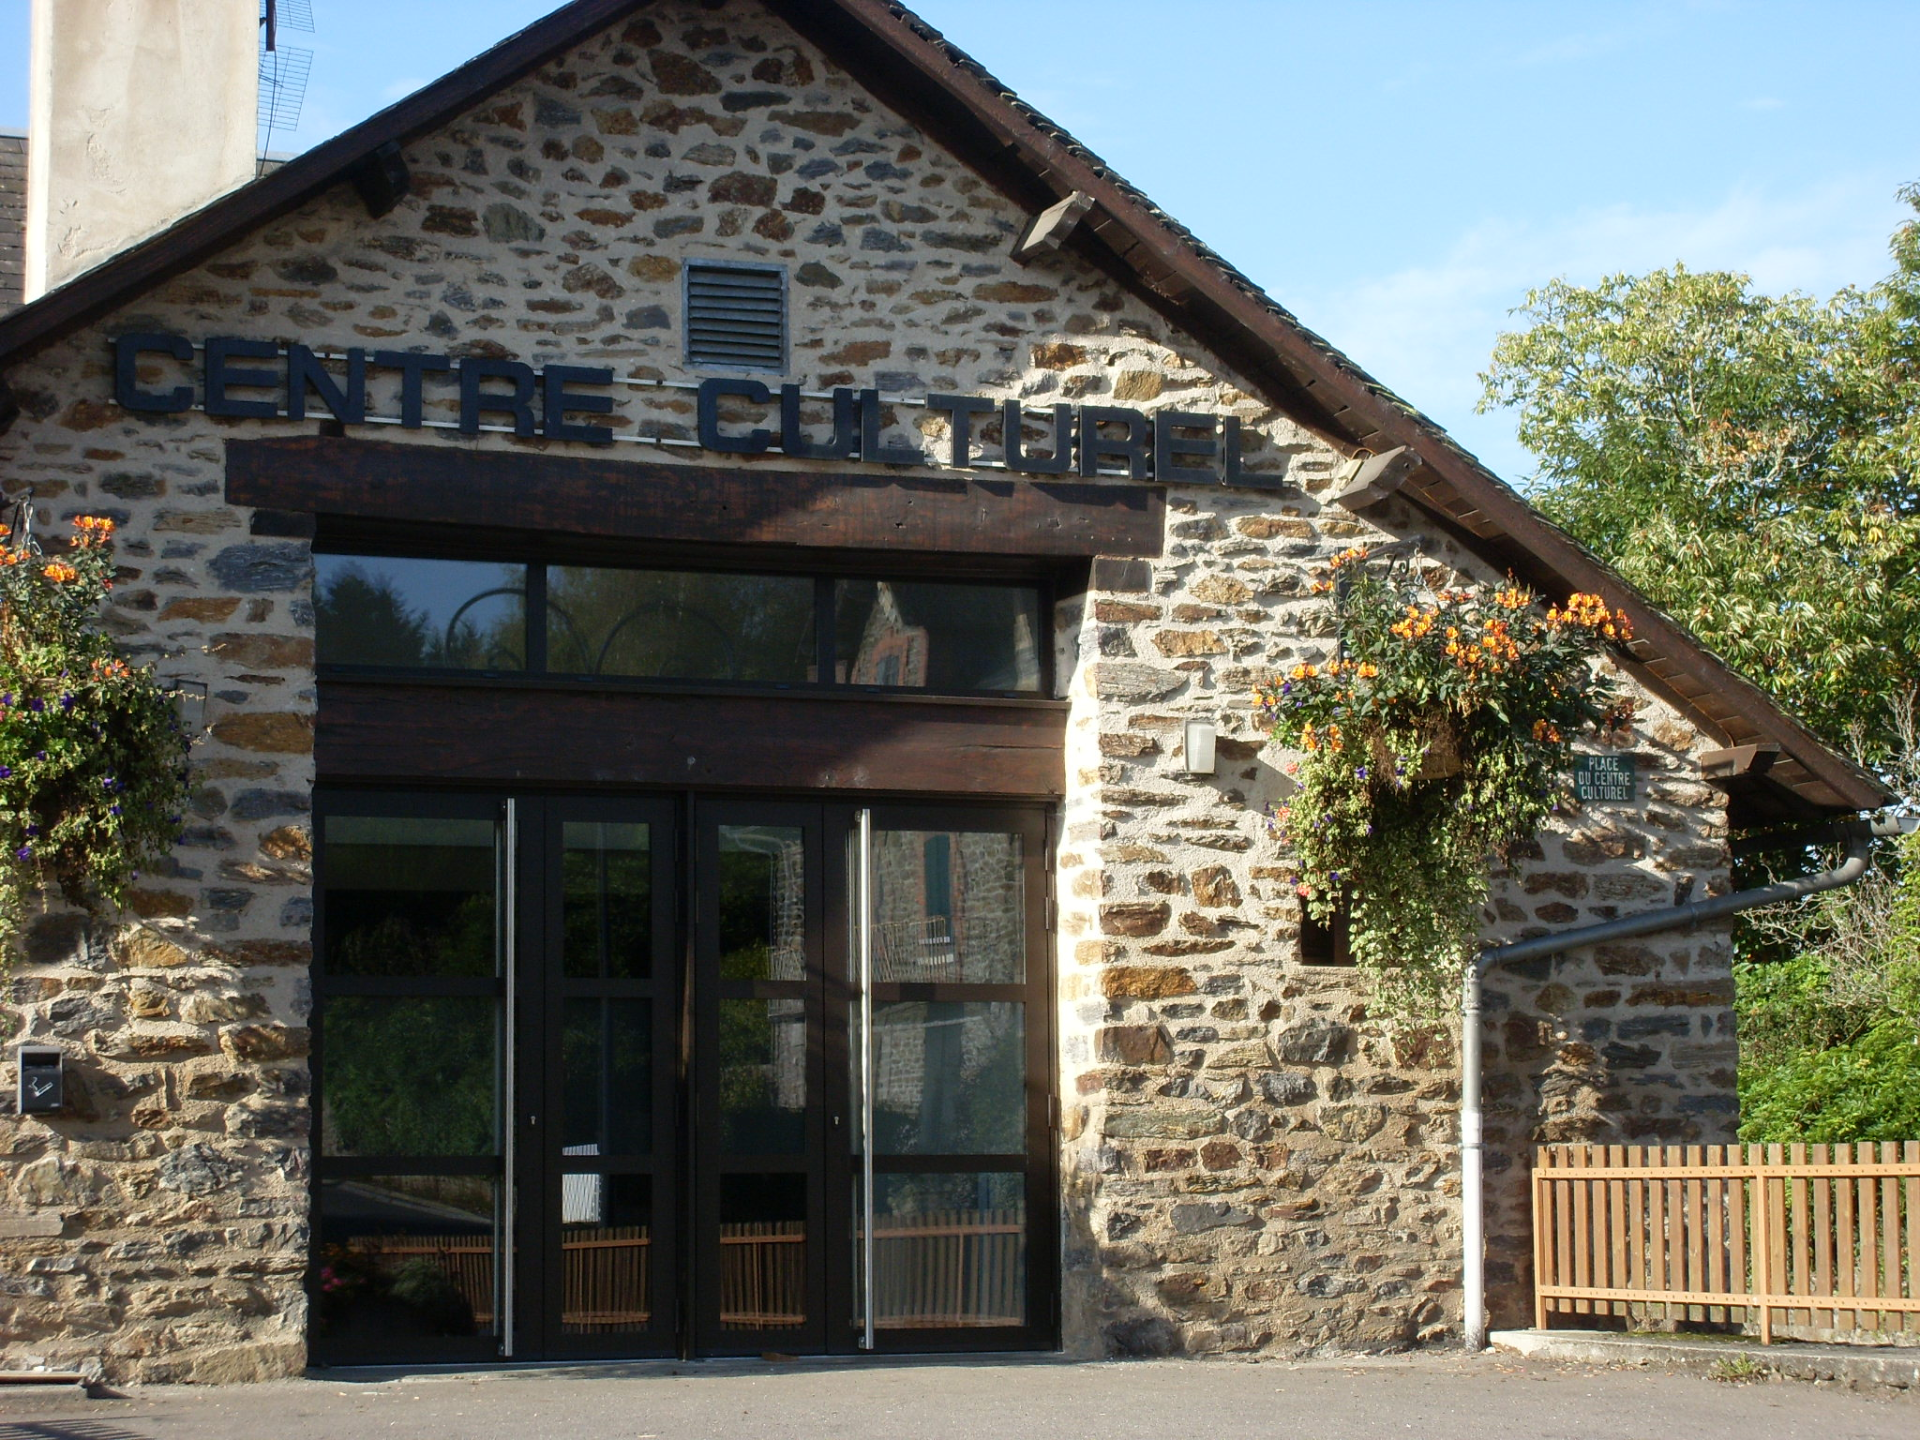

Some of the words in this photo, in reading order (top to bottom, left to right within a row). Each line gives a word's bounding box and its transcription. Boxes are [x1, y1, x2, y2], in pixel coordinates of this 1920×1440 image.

[115, 333, 613, 442] CENTRE
[699, 378, 1284, 488] CULTUREL
[1588, 757, 1619, 771] PLACE
[1578, 772, 1591, 785] DU
[1594, 772, 1631, 786] CENTRE
[1581, 786, 1629, 800] CULTUREL
